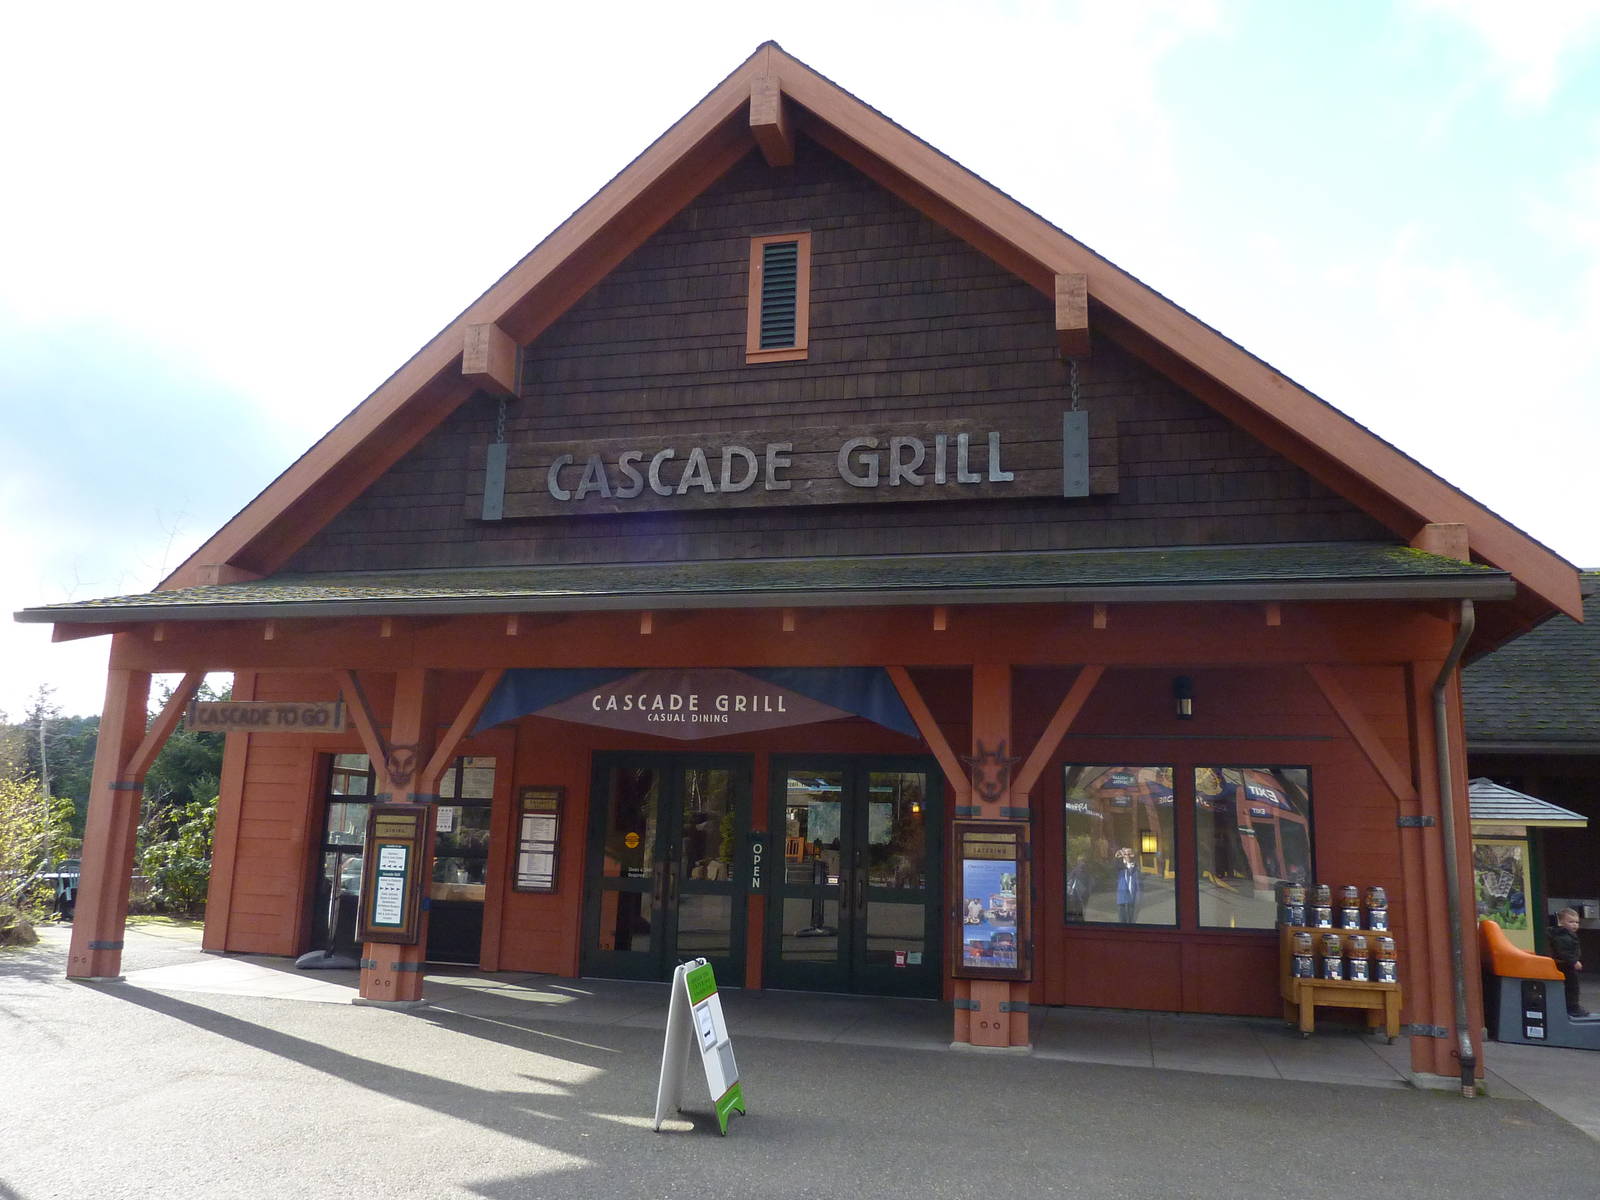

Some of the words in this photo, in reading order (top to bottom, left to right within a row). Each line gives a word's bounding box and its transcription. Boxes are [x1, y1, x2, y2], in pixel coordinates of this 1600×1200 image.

[546, 441, 793, 502] CASCADE
[837, 431, 1015, 488] GRILL
[591, 694, 699, 711] CASCADE
[715, 694, 787, 712] GRILL
[200, 708, 272, 725] CASCADE
[276, 708, 298, 725] TO
[302, 708, 328, 726] GO
[647, 713, 686, 722] CASUAL
[691, 713, 729, 723] DINING
[752, 843, 762, 888] OPEN
